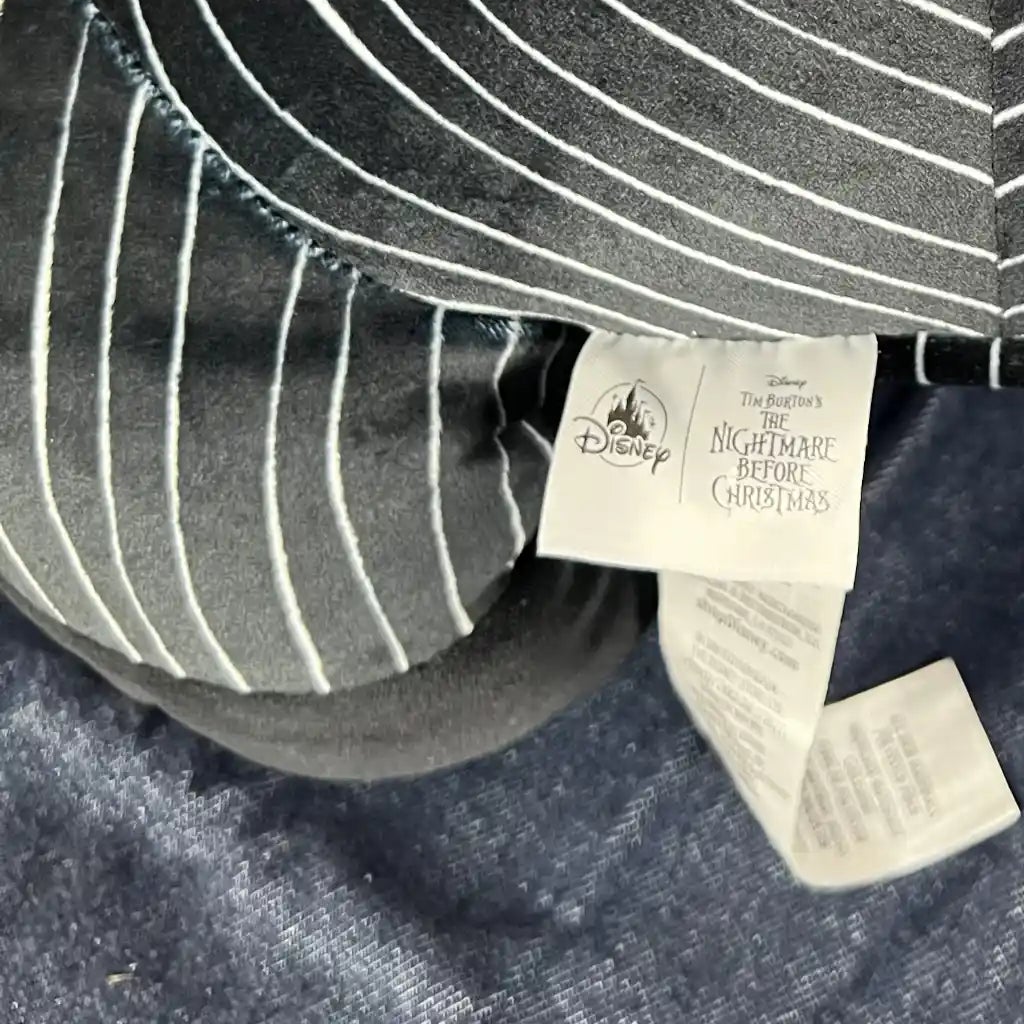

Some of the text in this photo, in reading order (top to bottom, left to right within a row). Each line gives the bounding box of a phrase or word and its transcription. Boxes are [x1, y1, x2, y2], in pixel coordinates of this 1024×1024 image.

[760, 410, 791, 432] THE
[709, 419, 840, 463] NIGHTMARE
[736, 457, 814, 486] BEFORE
[711, 474, 832, 517] CHRISTMAS
